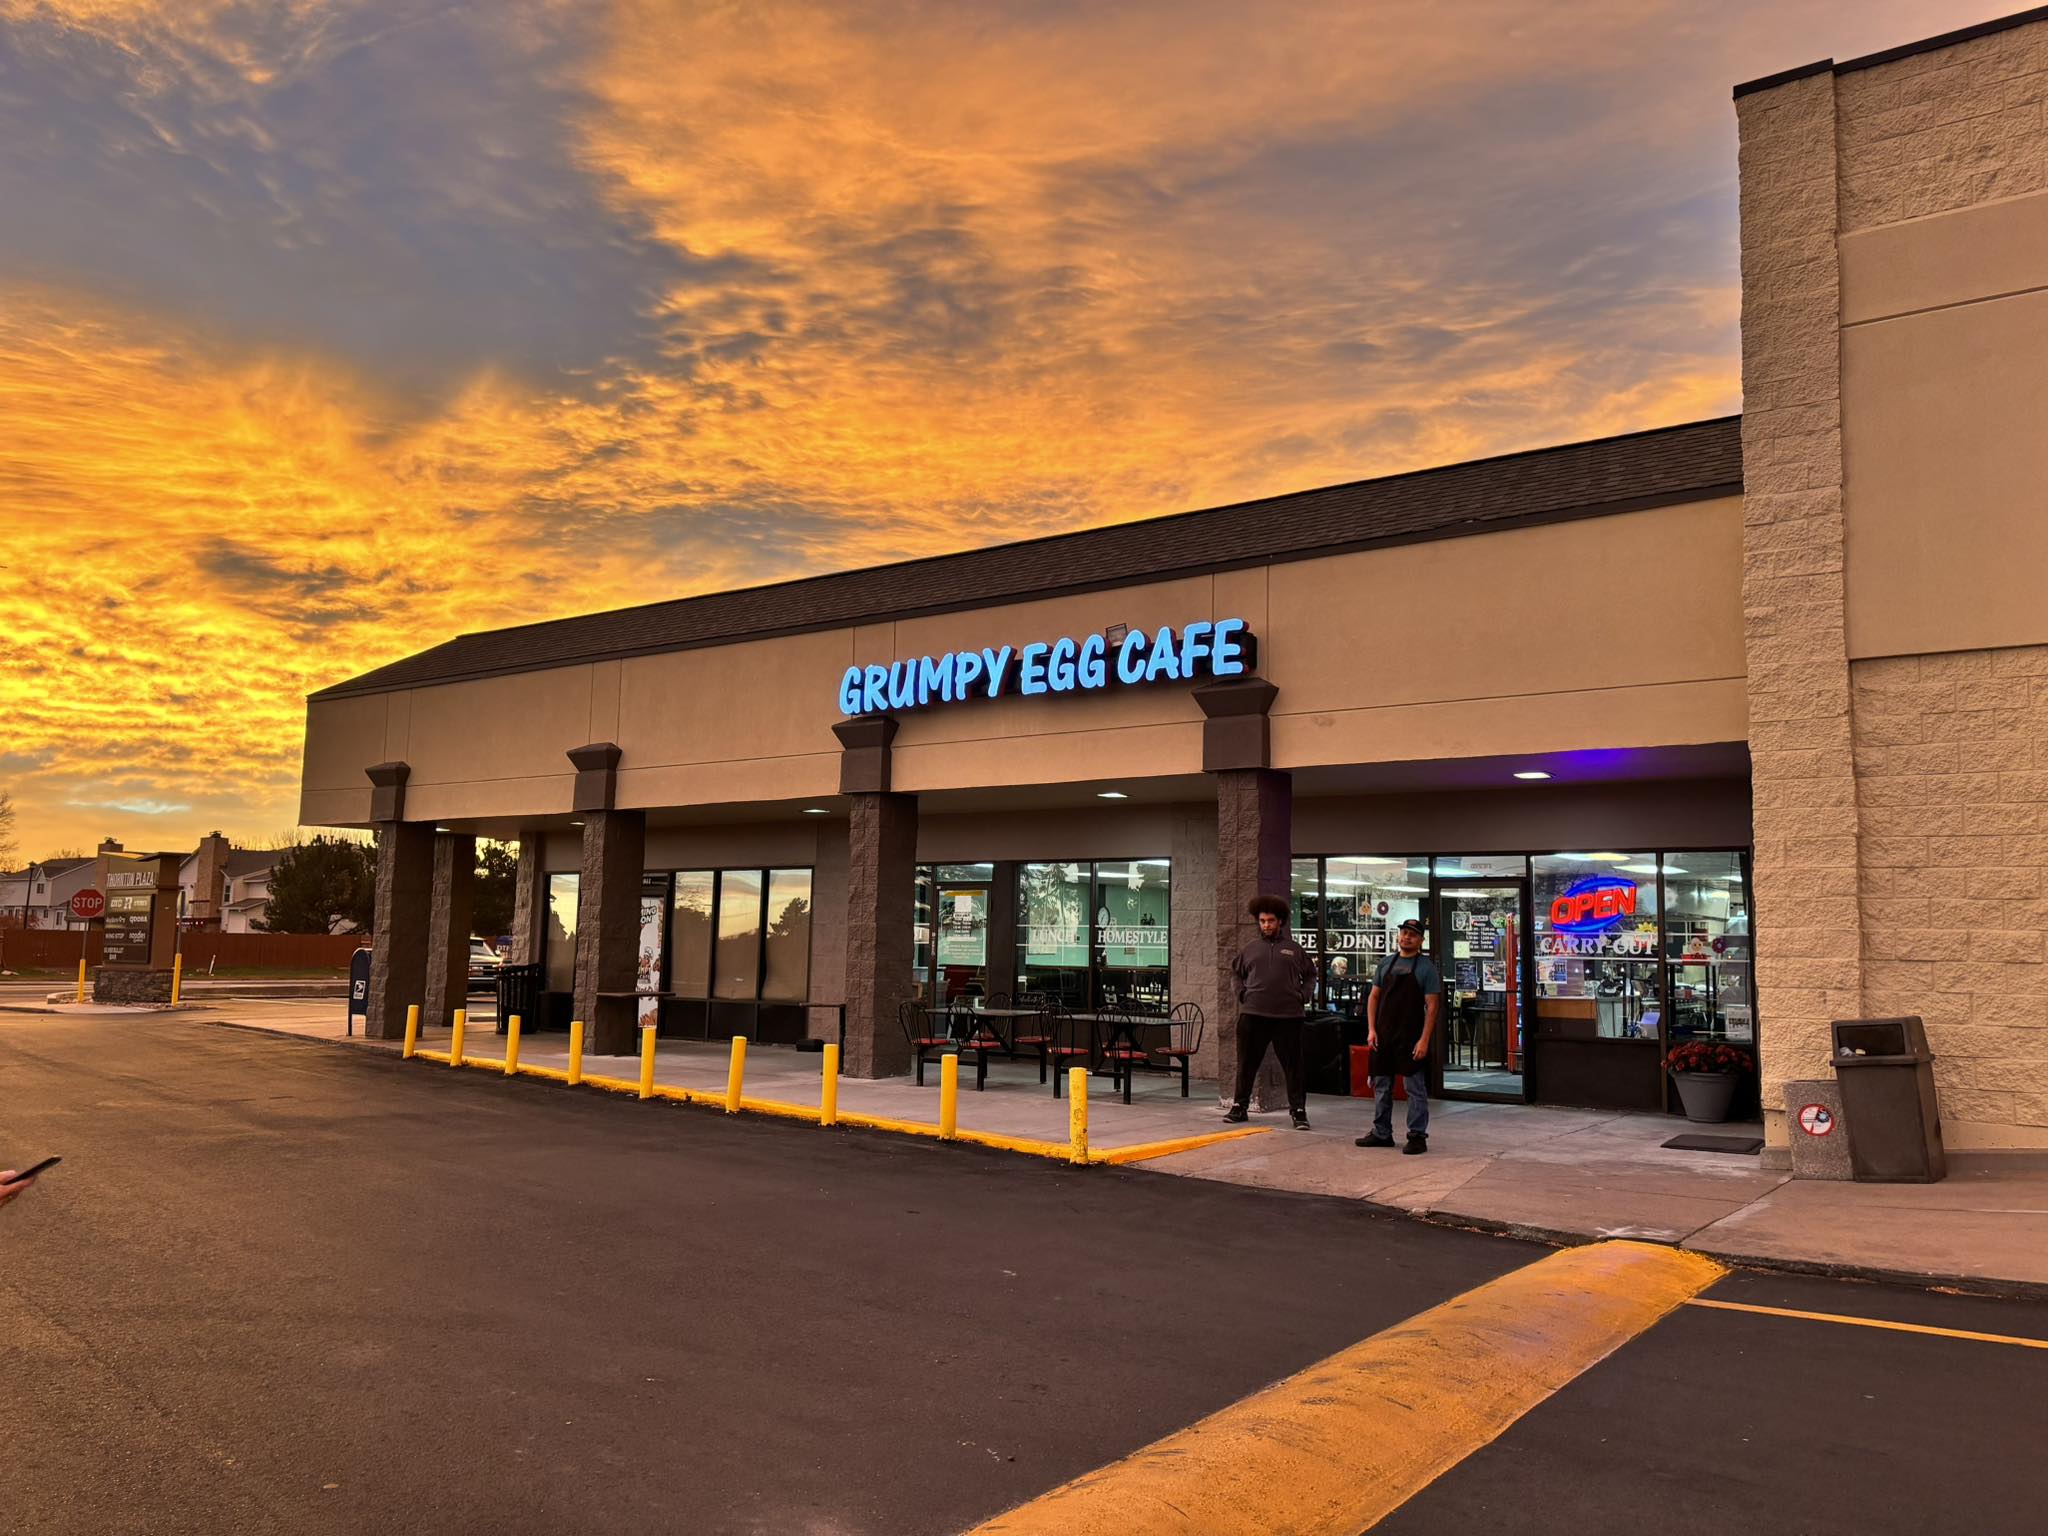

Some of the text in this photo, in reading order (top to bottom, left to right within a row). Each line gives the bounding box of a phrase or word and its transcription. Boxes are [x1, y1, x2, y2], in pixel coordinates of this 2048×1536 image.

[838, 617, 1246, 715] GRUMPY EGG CAFE
[107, 872, 154, 887] THORNTON PLAZA
[72, 896, 103, 909] STOP
[1551, 886, 1637, 925] OPEN
[640, 906, 657, 917] ING
[640, 916, 653, 924] ON
[1032, 930, 1075, 943] LUNCH
[1098, 930, 1168, 944] HOMESTYLE
[1291, 934, 1317, 949] FEE
[1343, 934, 1400, 949] DINE-I
[1540, 935, 1657, 956] CARRY-OUT
